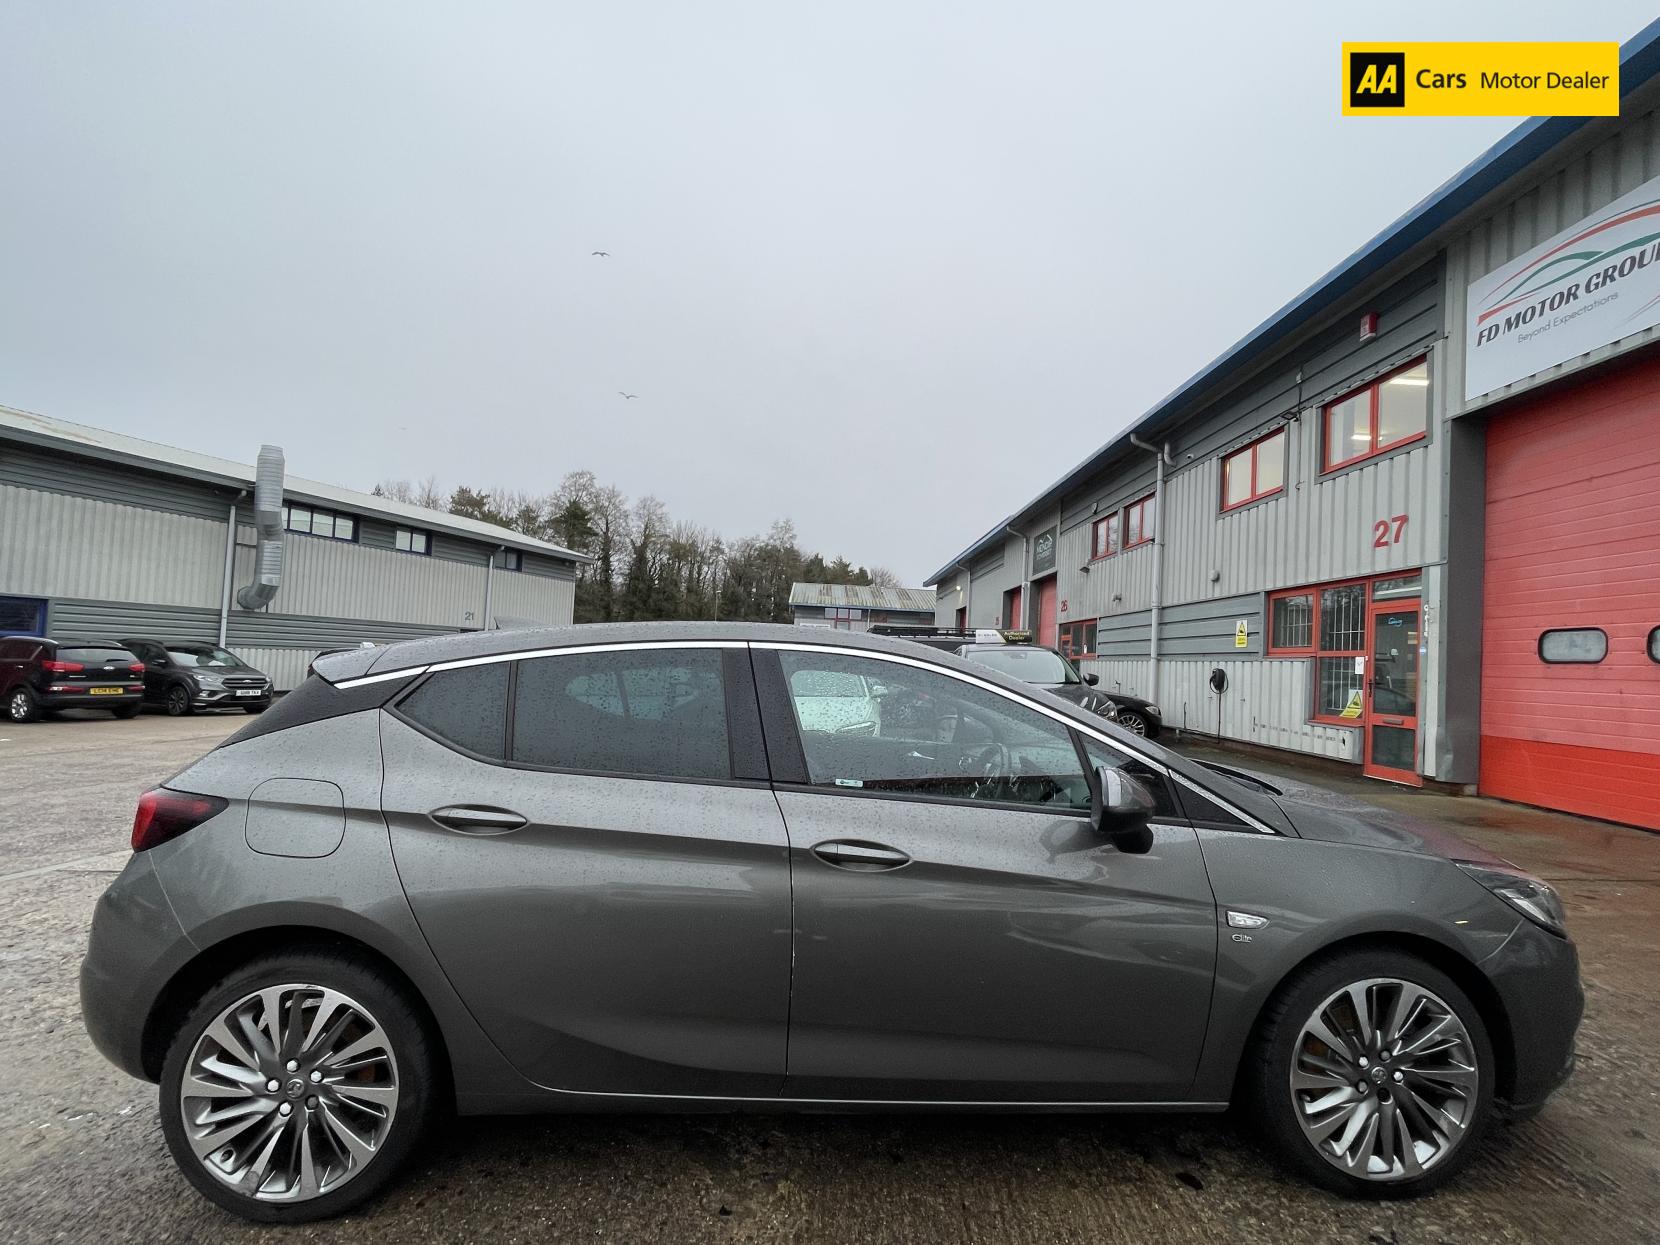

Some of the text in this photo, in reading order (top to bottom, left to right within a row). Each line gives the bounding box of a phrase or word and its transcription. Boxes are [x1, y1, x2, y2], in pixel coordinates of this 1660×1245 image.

[1476, 323, 1500, 347] FD
[1502, 283, 1581, 335] MOTOR
[1517, 292, 1619, 344] Beyond Expectations
[1374, 514, 1409, 548] 27
[464, 611, 474, 621] 21
[1060, 600, 1068, 612] 26
